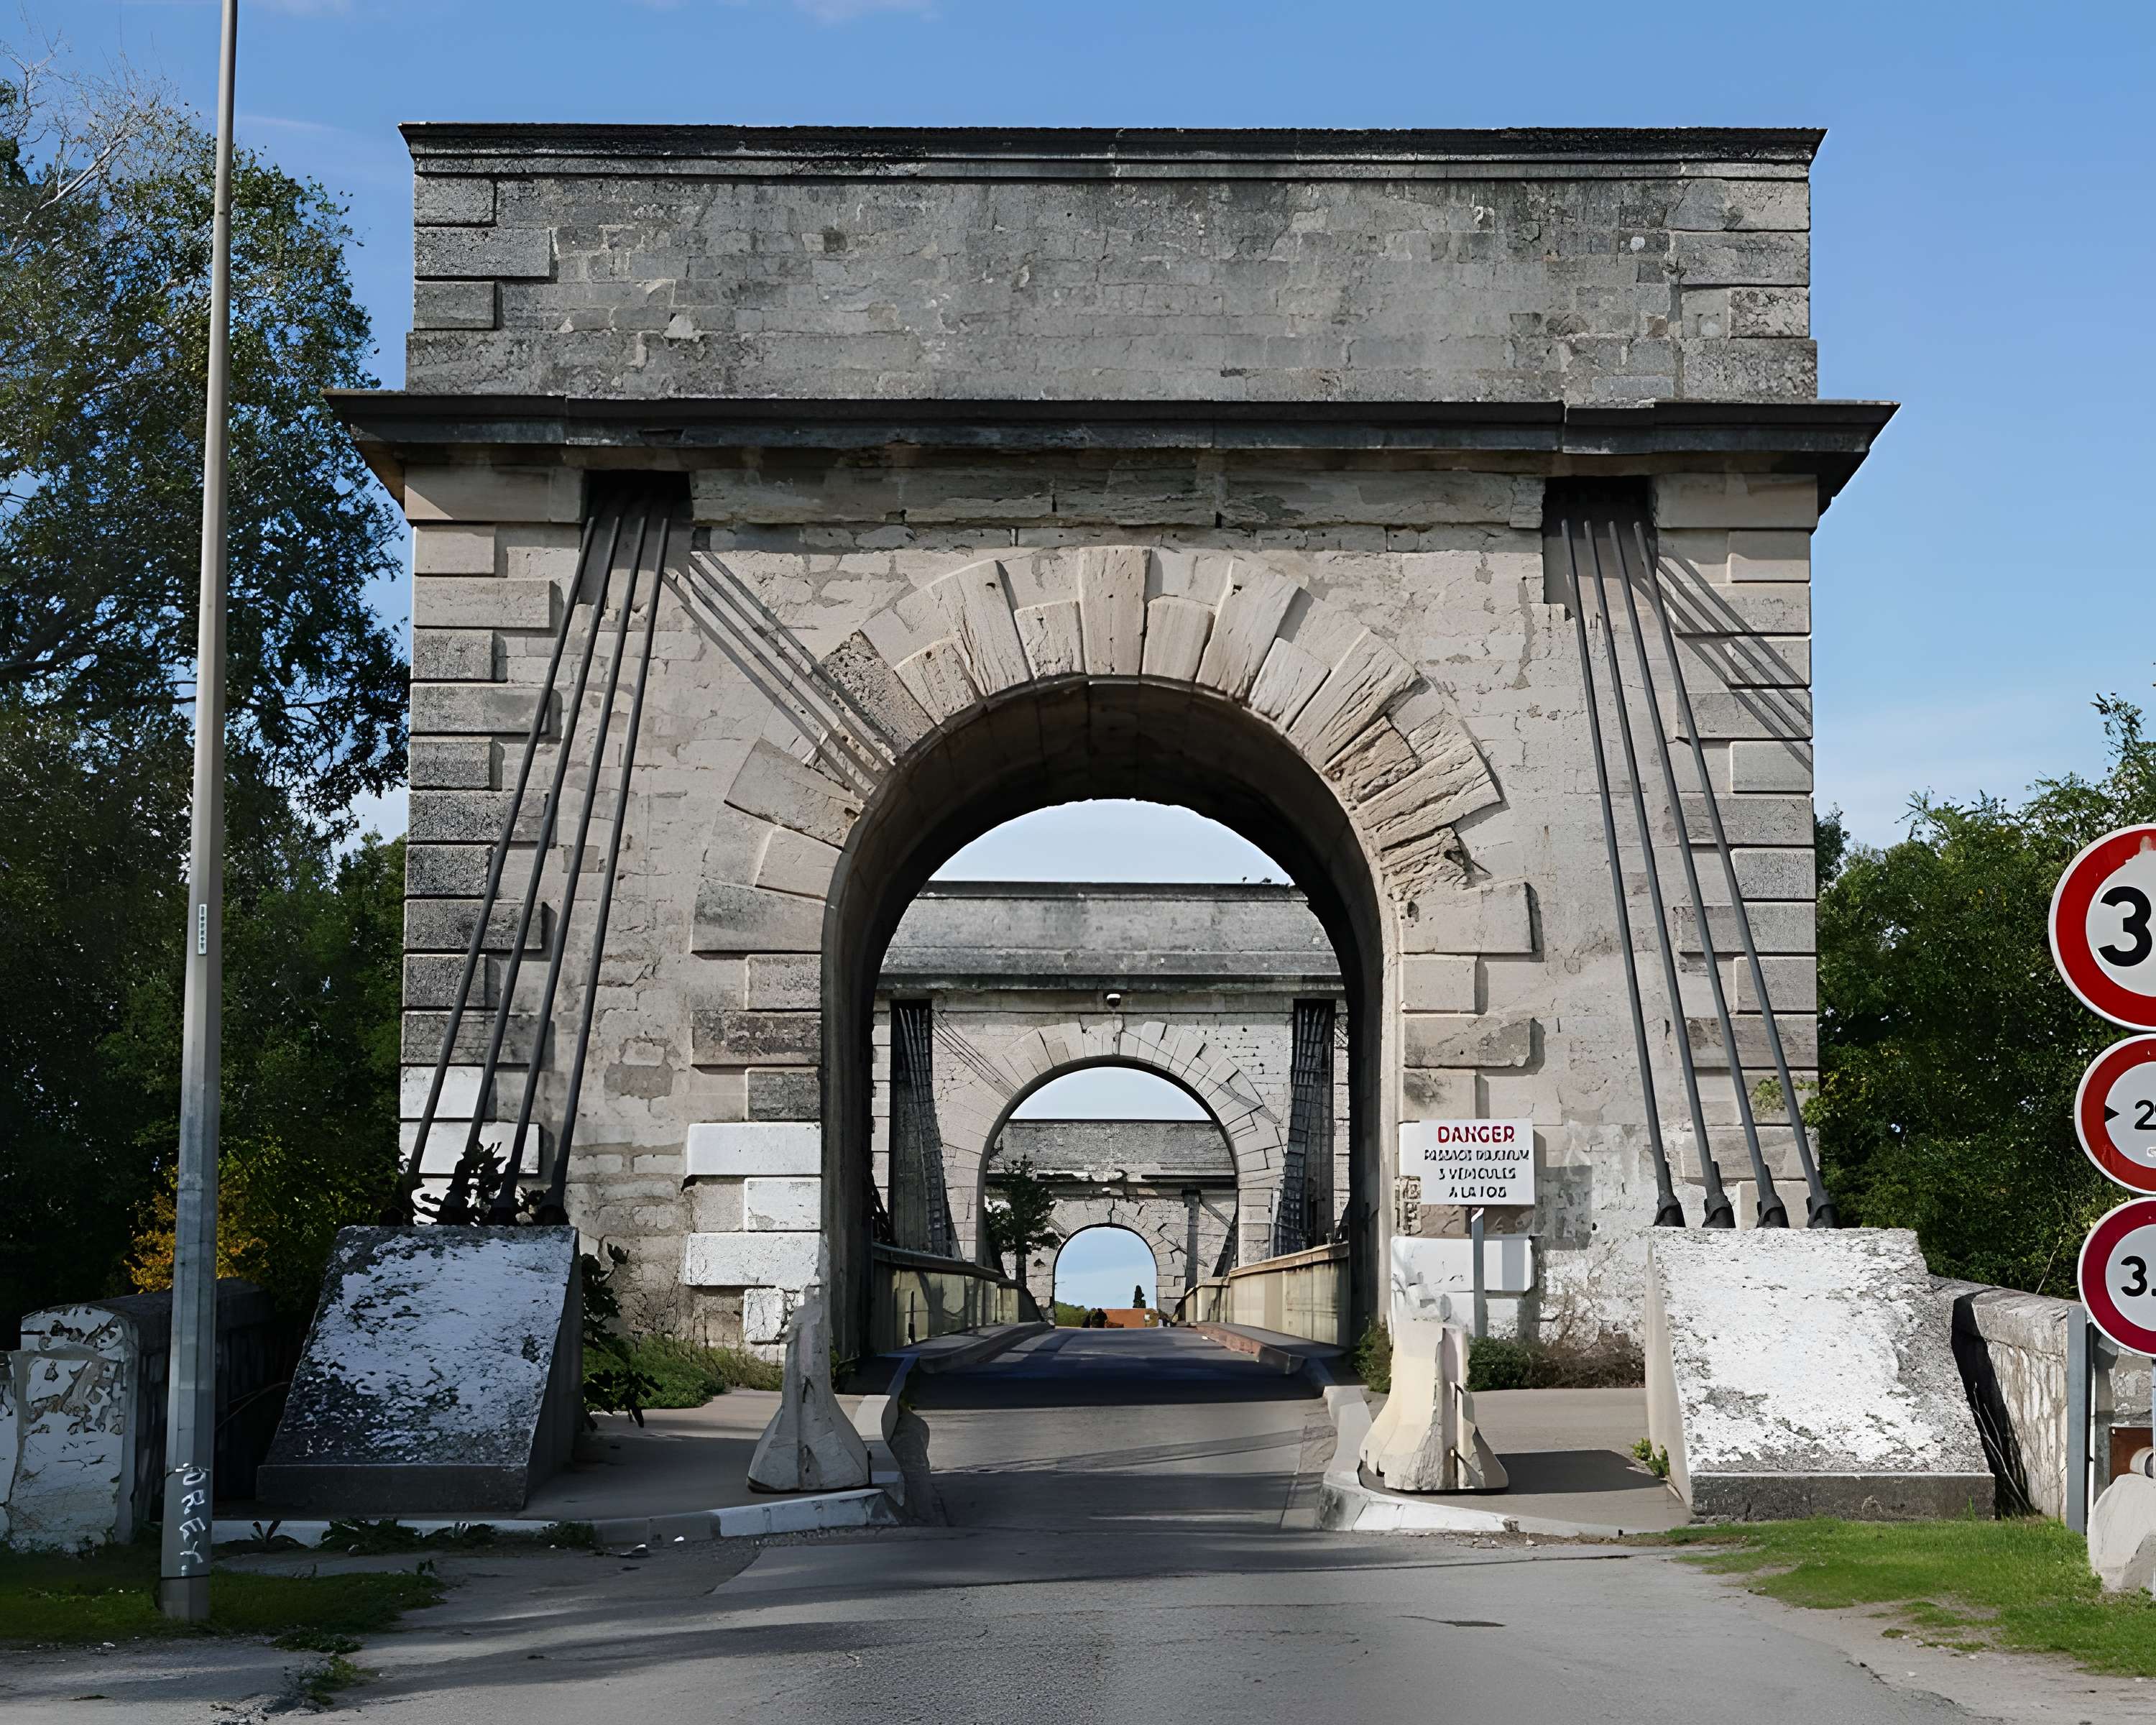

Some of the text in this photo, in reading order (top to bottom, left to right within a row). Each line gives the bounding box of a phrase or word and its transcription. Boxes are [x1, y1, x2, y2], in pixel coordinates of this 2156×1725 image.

[2098, 886, 2153, 967] 3
[2134, 1099, 2156, 1131] 2
[1437, 1126, 1515, 1144] DANGER
